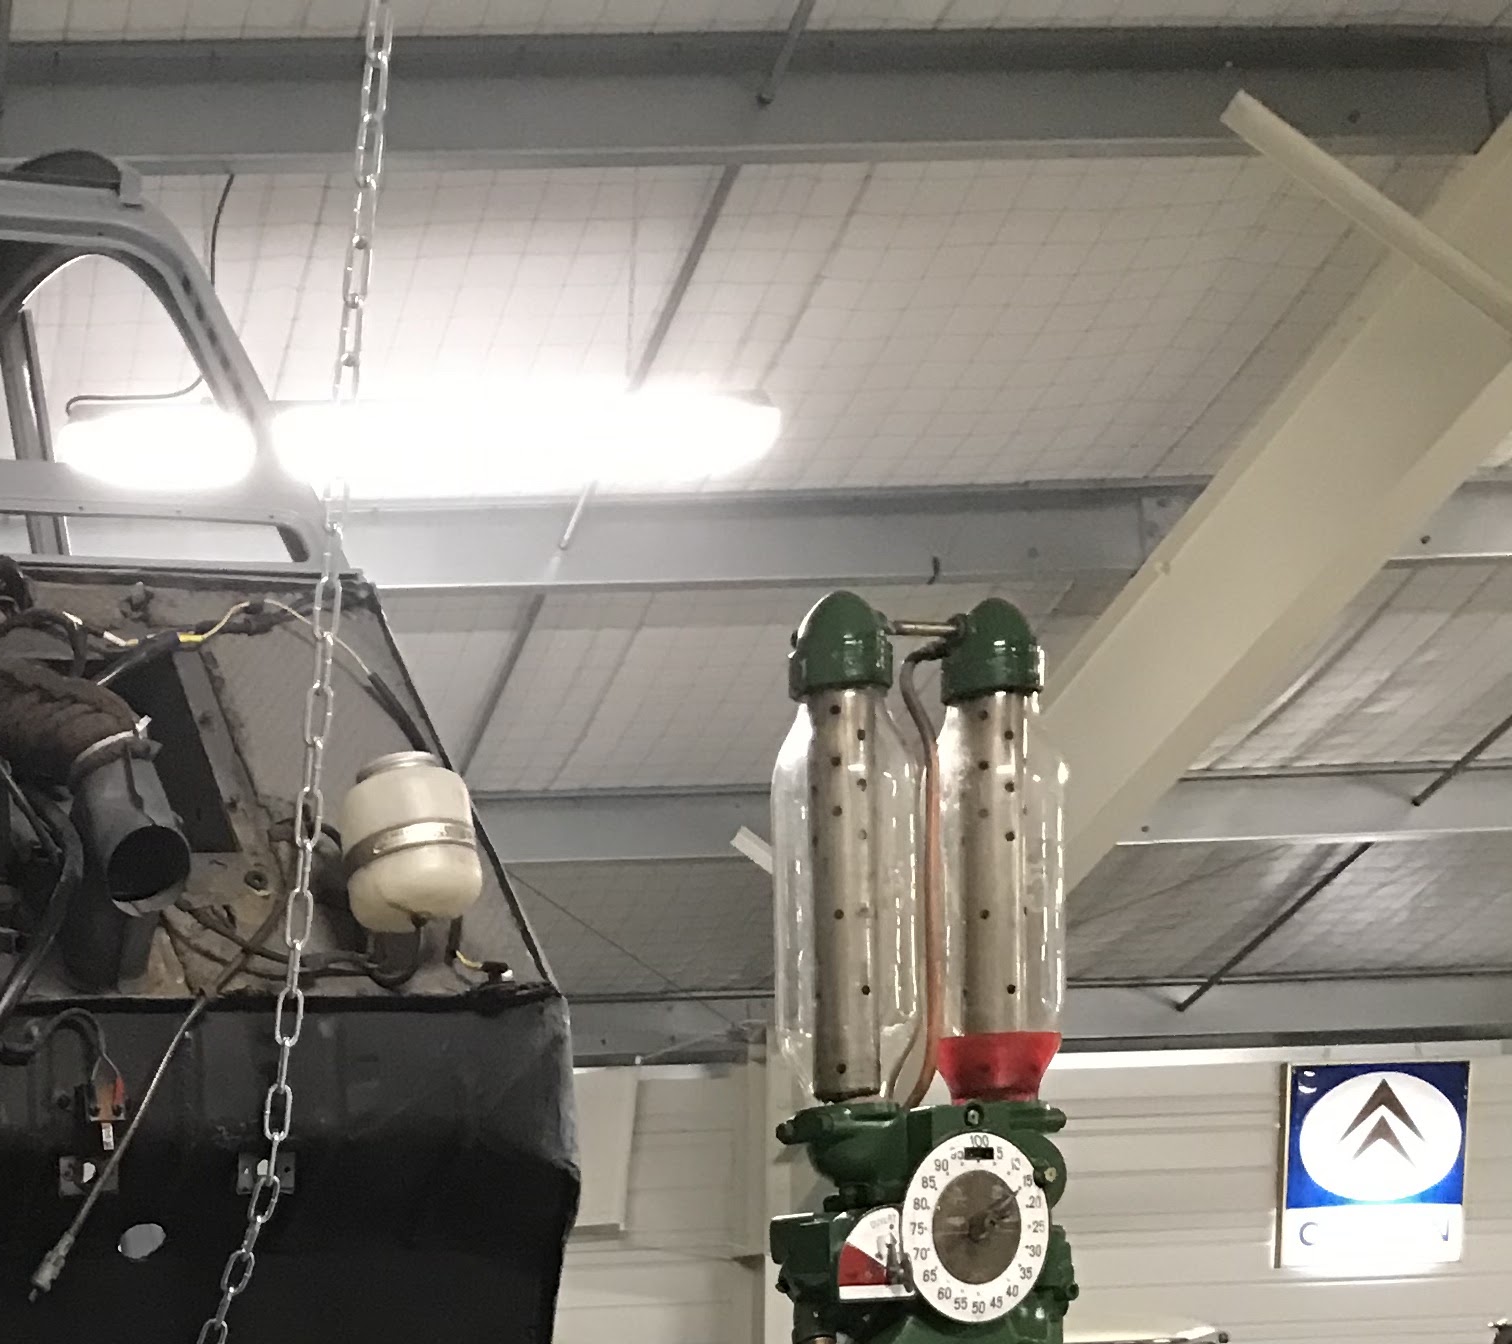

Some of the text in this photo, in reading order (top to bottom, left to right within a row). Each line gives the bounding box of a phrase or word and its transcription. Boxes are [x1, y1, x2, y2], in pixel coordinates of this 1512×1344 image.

[970, 1135, 989, 1148] 100
[997, 1146, 1004, 1160] 5
[934, 1159, 949, 1172] 90
[921, 1175, 936, 1189] 85
[1023, 1174, 1033, 1188] 15
[913, 1197, 928, 1210] 80
[1029, 1195, 1042, 1209] 20
[910, 1222, 924, 1235] 75
[1032, 1220, 1045, 1233] 25
[913, 1247, 928, 1261] 70
[1029, 1244, 1042, 1258] 30
[922, 1269, 937, 1282] 65
[1019, 1266, 1033, 1280] 35
[937, 1287, 952, 1300] 60
[1006, 1284, 1019, 1298] 40
[954, 1297, 968, 1310] 55
[972, 1301, 986, 1314] 50
[990, 1295, 1003, 1309] 45
